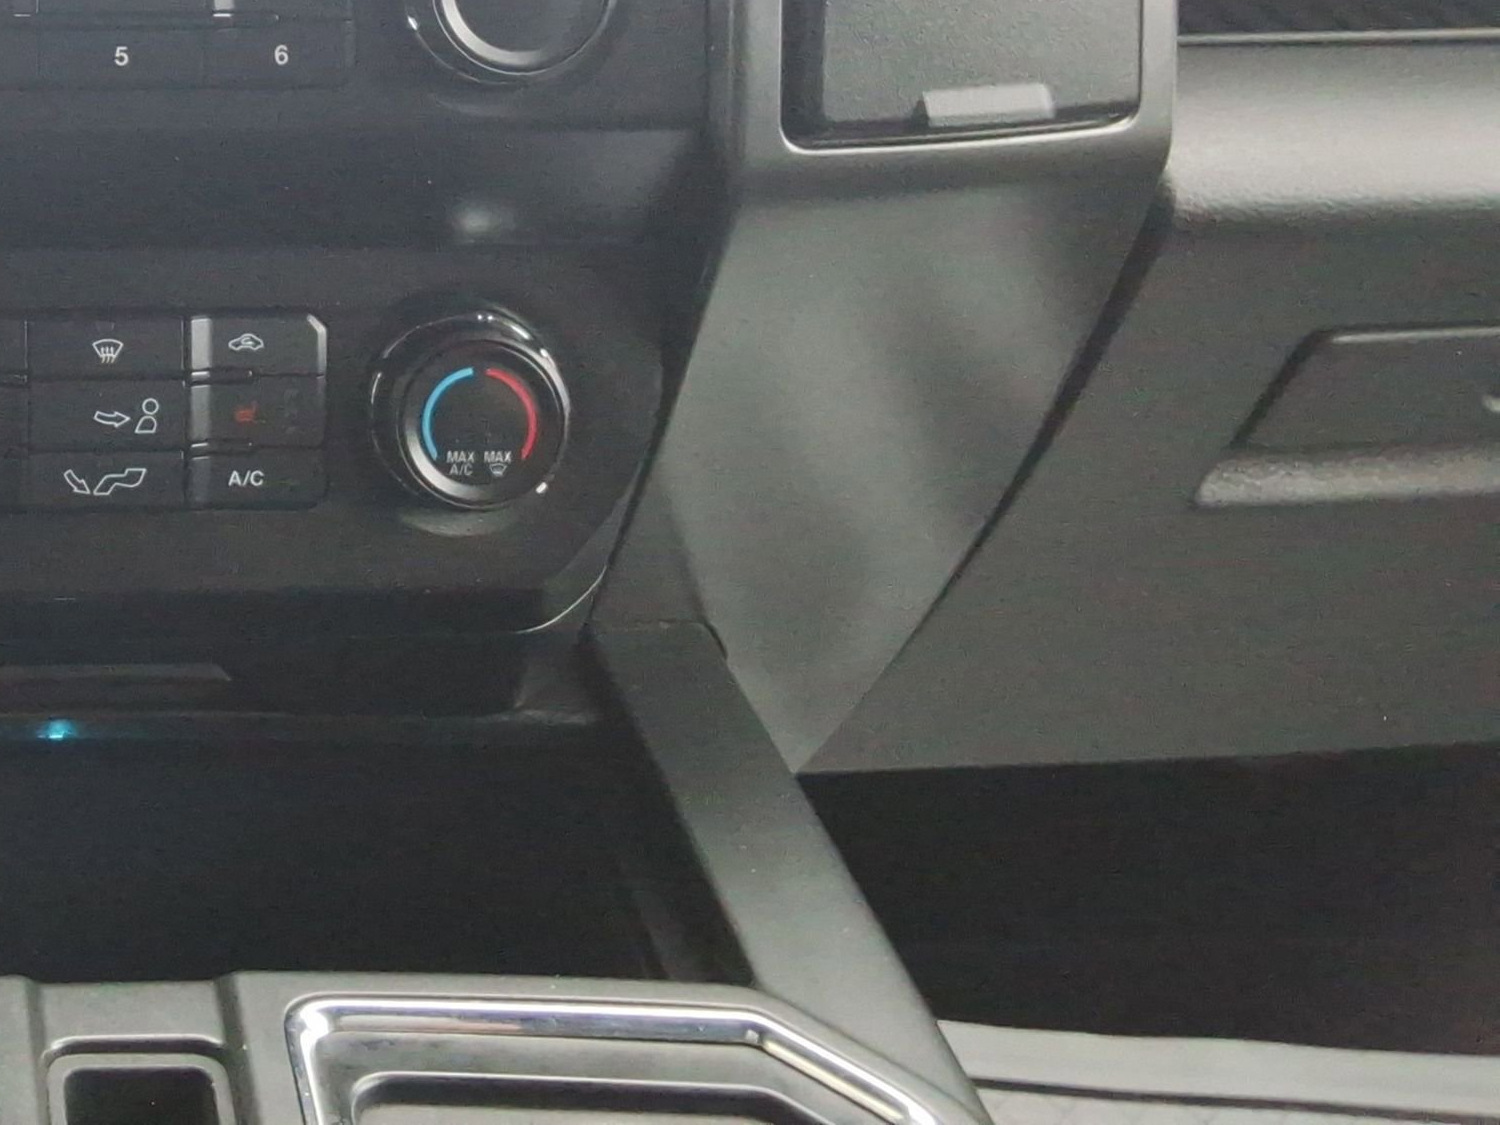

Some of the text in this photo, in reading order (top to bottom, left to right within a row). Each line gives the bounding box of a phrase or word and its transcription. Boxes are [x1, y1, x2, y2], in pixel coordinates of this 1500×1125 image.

[114, 46, 129, 66] 5
[274, 45, 289, 65] 6
[446, 450, 475, 463] MAX
[484, 450, 512, 463] MAX
[449, 463, 473, 475] A/C
[228, 471, 264, 487] A/C
